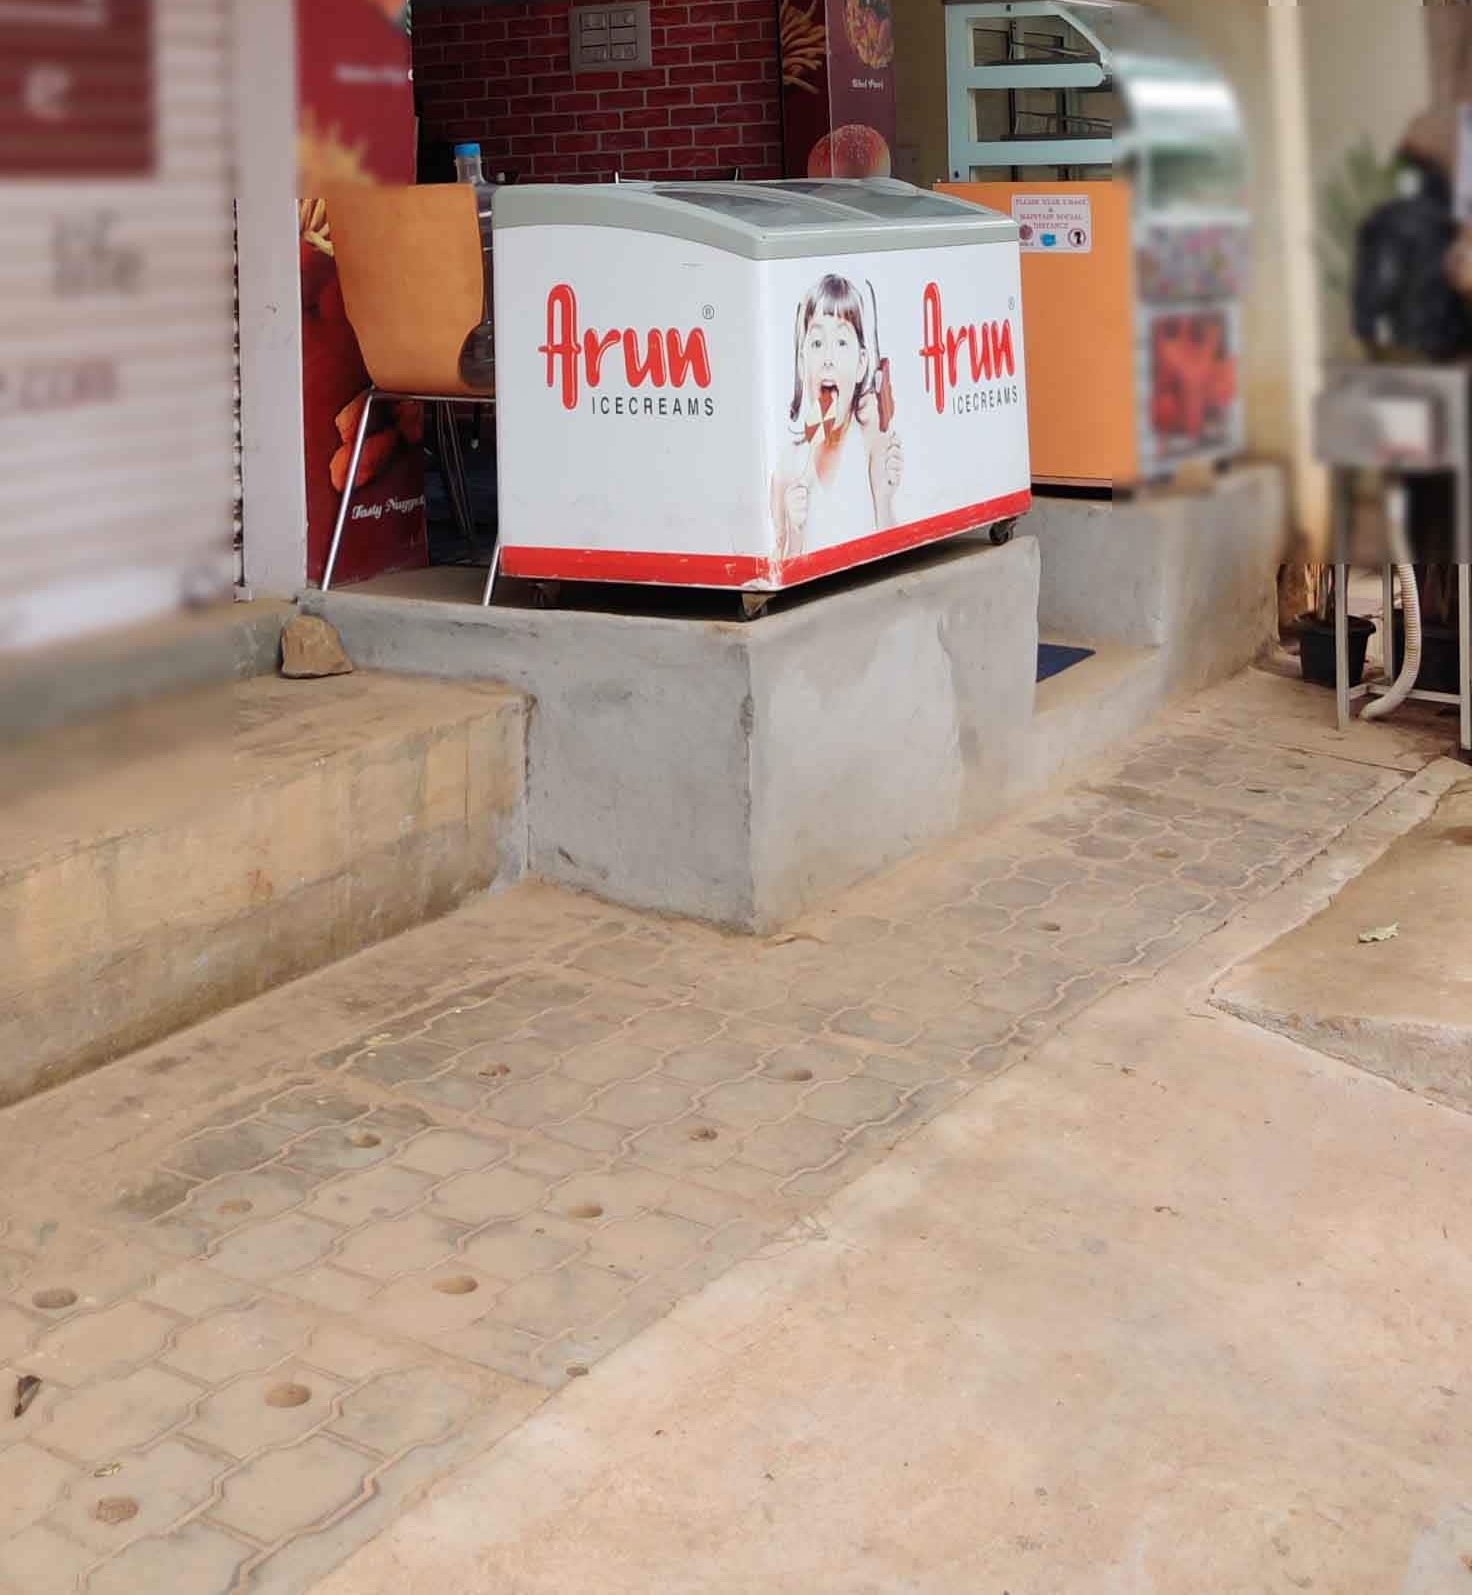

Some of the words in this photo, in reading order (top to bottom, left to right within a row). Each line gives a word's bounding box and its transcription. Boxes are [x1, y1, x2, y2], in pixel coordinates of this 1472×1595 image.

[538, 283, 712, 410] Arun
[919, 282, 1015, 414] Arun
[592, 395, 714, 417] ICECREAMS
[952, 385, 1018, 414] ICECREAMS
[351, 503, 383, 520] Tasty
